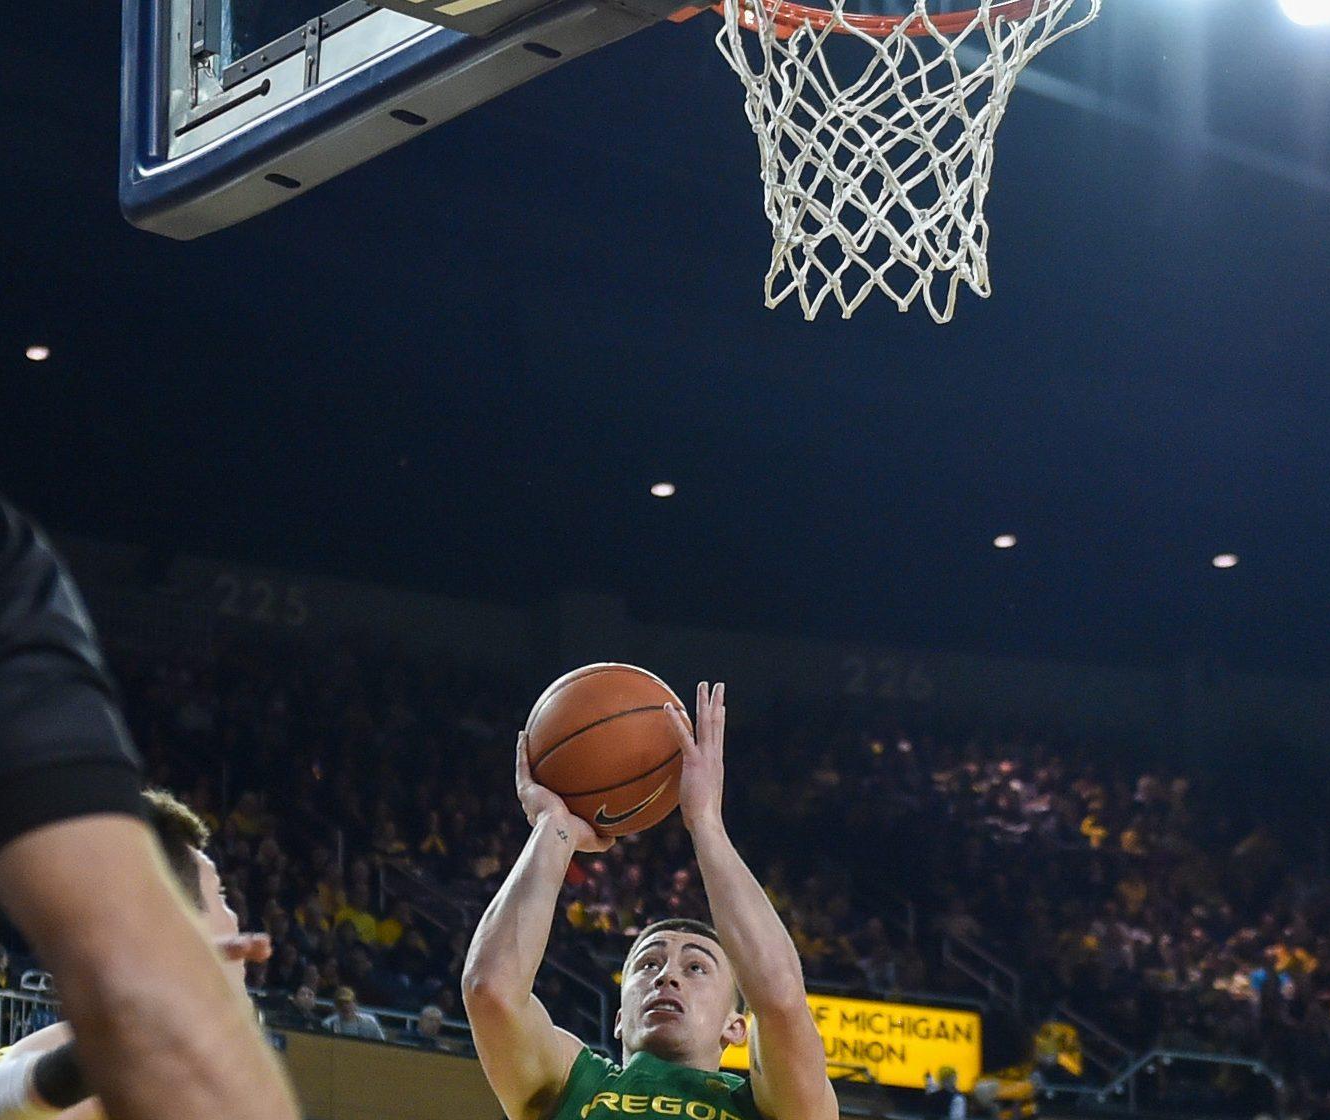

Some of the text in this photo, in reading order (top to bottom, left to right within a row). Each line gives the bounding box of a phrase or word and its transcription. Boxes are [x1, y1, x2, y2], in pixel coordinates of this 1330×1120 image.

[214, 573, 308, 626] 225
[839, 1010, 973, 1042] MICHIGAN
[822, 1036, 906, 1064] UNION
